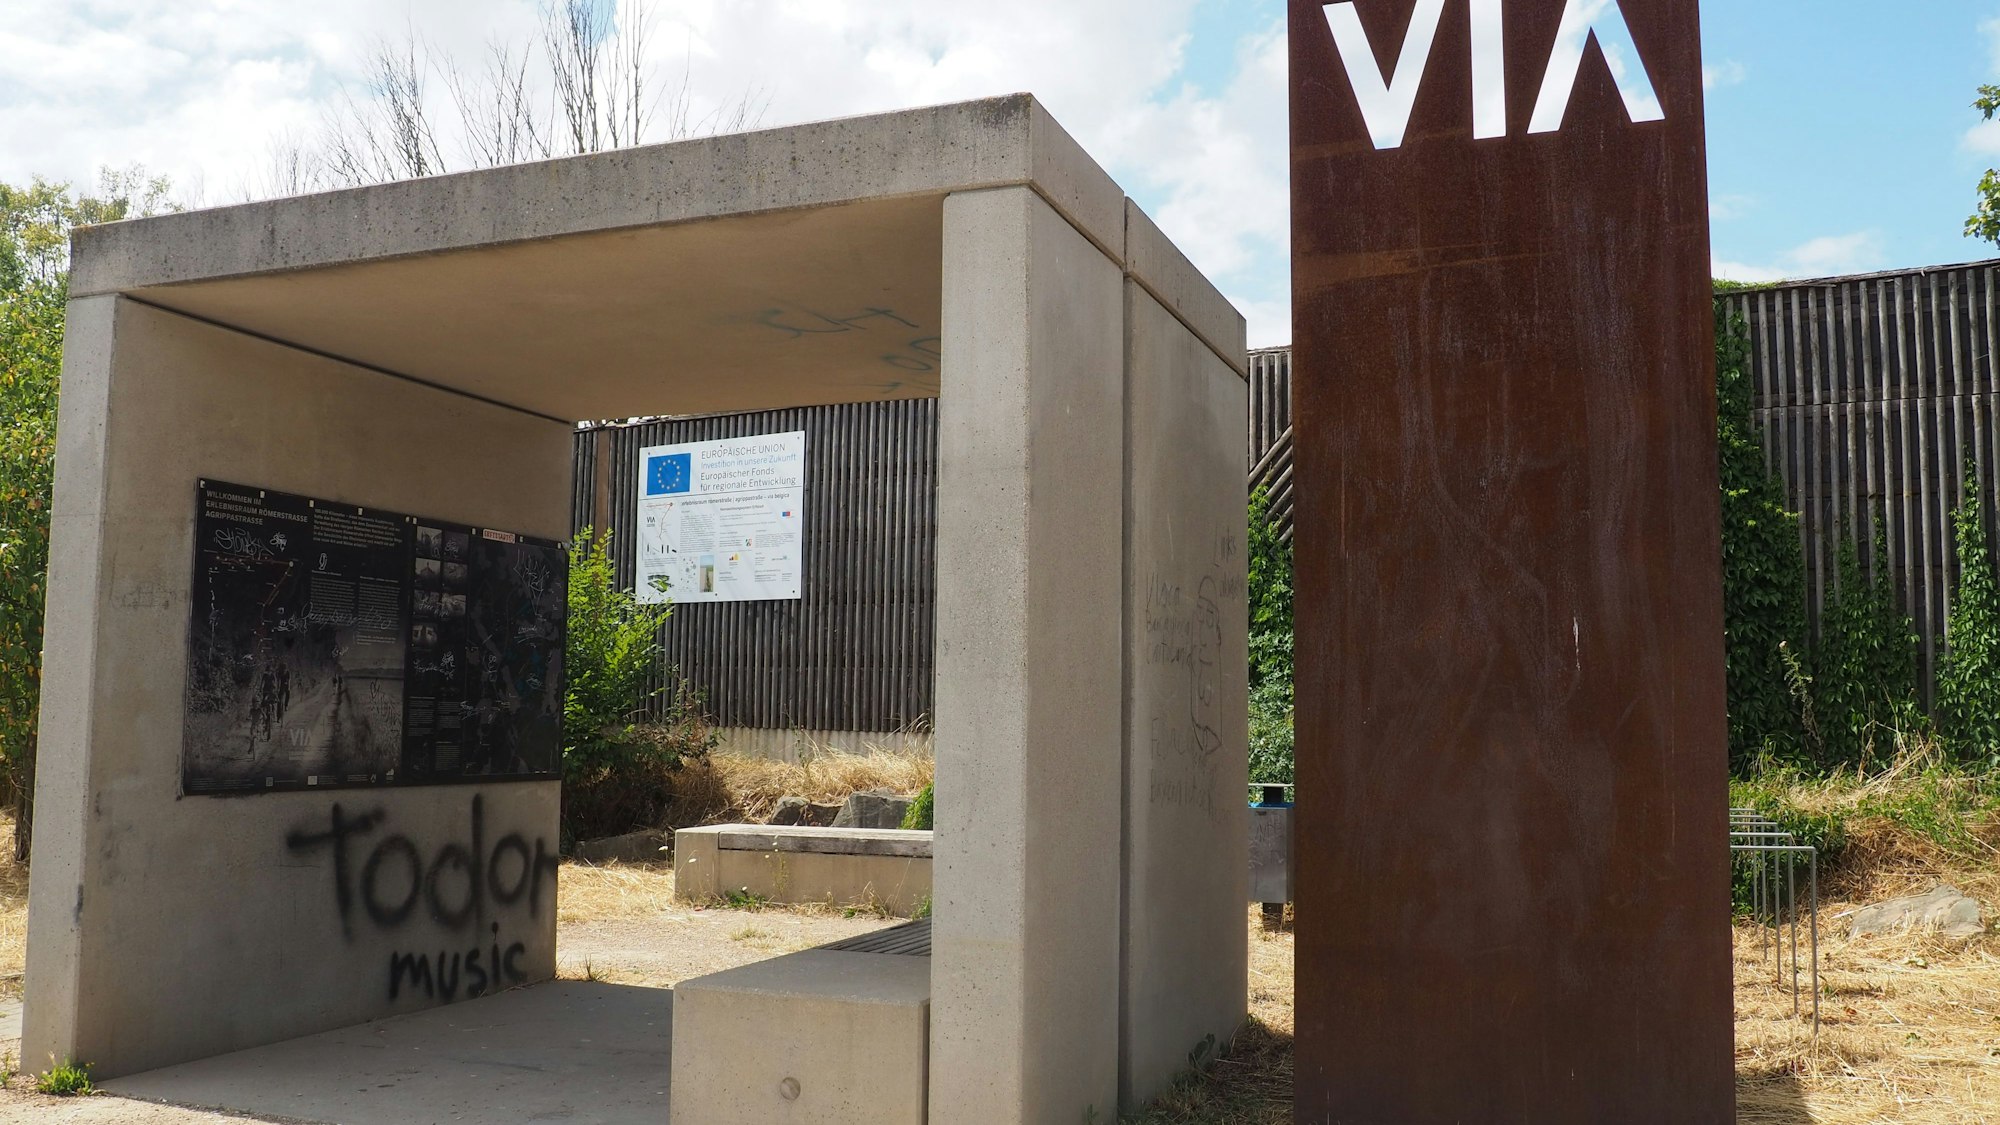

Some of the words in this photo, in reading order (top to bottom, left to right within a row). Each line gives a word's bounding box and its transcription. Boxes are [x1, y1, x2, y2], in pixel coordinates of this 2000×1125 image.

[1322, 0, 1667, 150] VIA
[701, 446, 756, 459] EUROPÄISCHE
[758, 443, 785, 454] UNION
[701, 460, 736, 470] Investition
[744, 457, 768, 466] unsere
[768, 453, 796, 463] Zukunft
[700, 469, 750, 481] Europäischer
[751, 466, 775, 476] Fonds
[700, 482, 711, 492] für
[712, 480, 747, 491] regionale
[748, 476, 796, 487] Entwicklung
[206, 490, 253, 504] WILLKOMMEN
[253, 498, 262, 506] IM
[205, 500, 258, 515] ERLEBNISRAUM
[258, 508, 308, 523] RÖMERSTRASSE
[205, 510, 263, 525] AGRIPPASTRASSE
[289, 728, 313, 746] VIA
